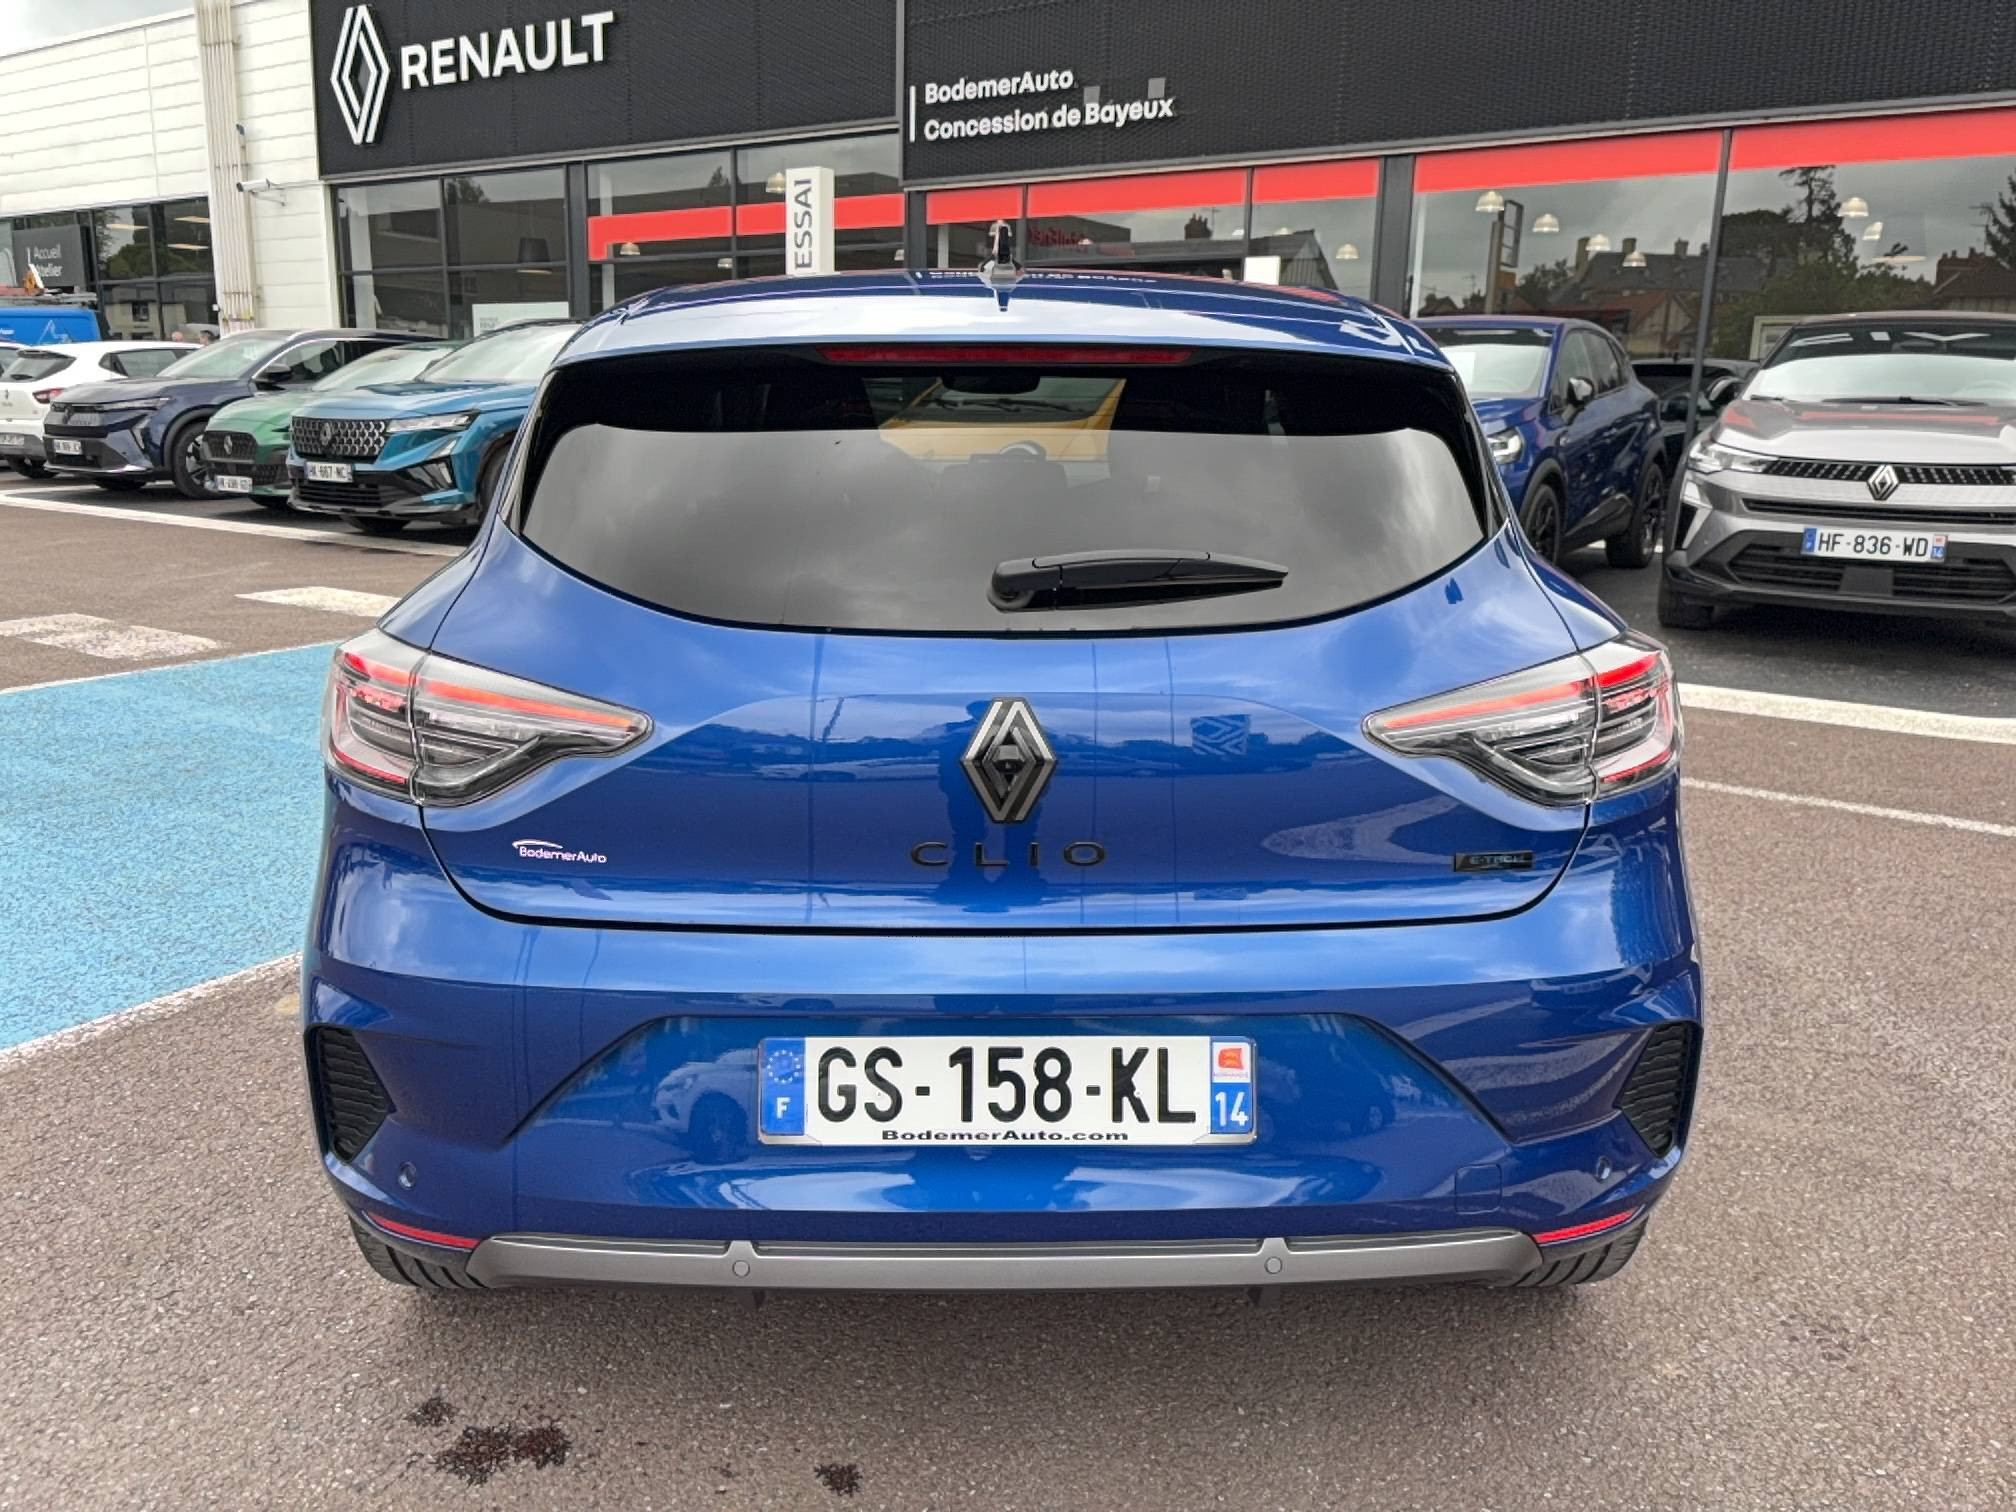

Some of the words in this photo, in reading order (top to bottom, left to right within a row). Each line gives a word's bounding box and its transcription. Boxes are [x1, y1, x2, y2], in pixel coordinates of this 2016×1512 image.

[401, 10, 615, 90] RENAULT
[924, 69, 1075, 104] BodemerAuto
[924, 108, 1049, 141] Concession
[1052, 104, 1082, 128] de
[1084, 97, 1176, 127] Bayeux
[794, 178, 812, 269] ESSAI
[33, 243, 62, 259] Accueil
[35, 262, 63, 277] telier
[1818, 532, 1930, 557] HF-836-WD
[519, 846, 608, 863] BodemerAuto
[910, 841, 1106, 867] CLIO
[818, 1046, 1196, 1123] GS-158-KL
[776, 1096, 792, 1120] F
[1215, 1091, 1249, 1126] 14
[882, 1129, 1129, 1142] BodemerAuto.com
